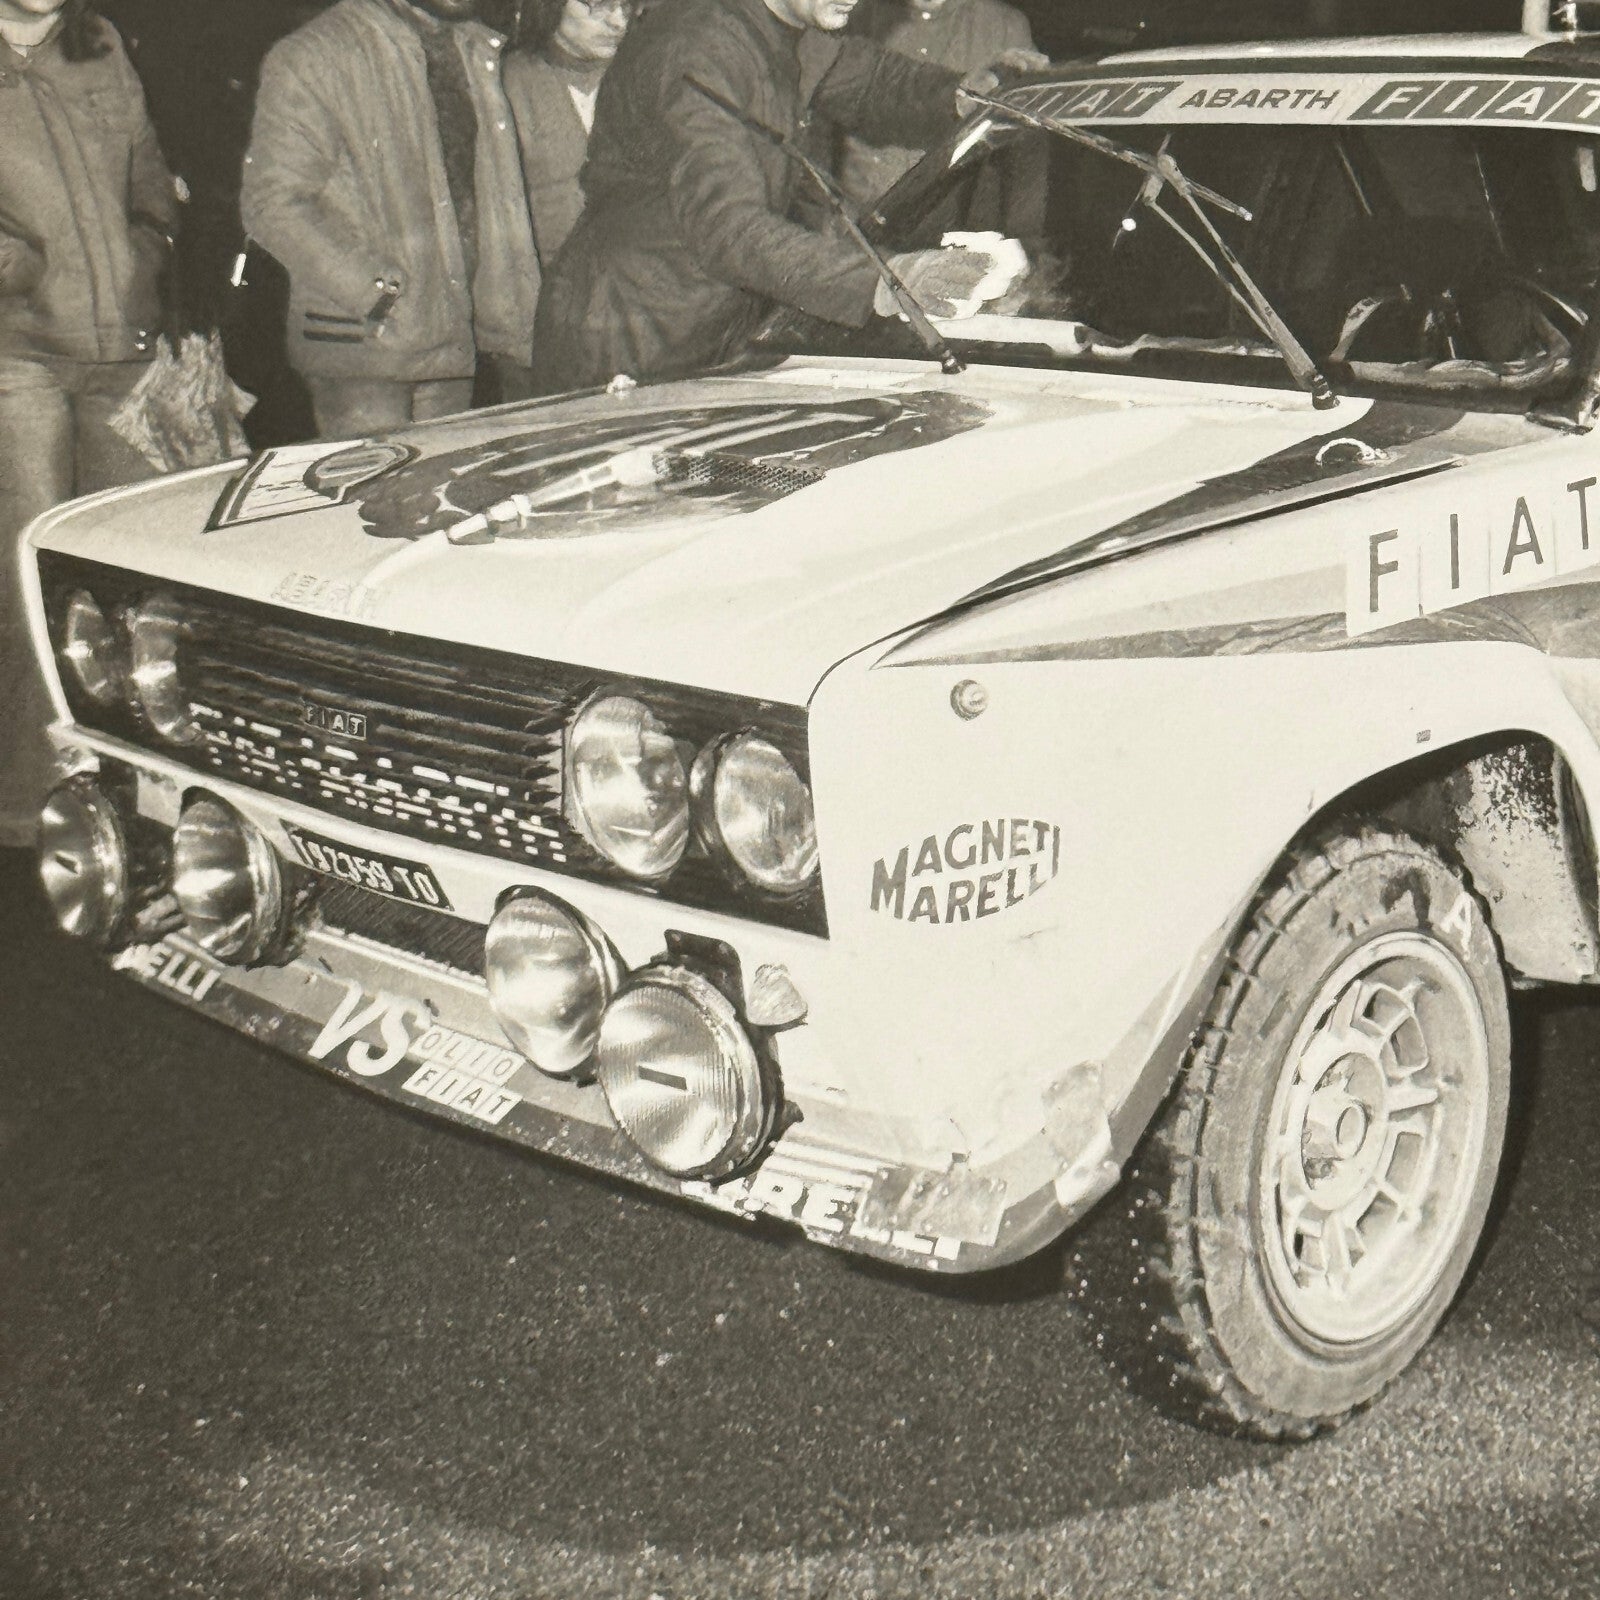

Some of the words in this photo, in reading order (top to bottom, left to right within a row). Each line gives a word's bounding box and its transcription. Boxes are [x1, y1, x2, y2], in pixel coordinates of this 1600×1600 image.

[1178, 88, 1341, 110] ABARTH
[1368, 476, 1598, 613] FIAT
[306, 705, 364, 736] FIAT
[870, 818, 1061, 895] MAGNETI
[392, 865, 440, 904] TO
[307, 979, 431, 1077] VS
[420, 1031, 514, 1079] OLIO
[412, 1068, 513, 1115] FIAT
